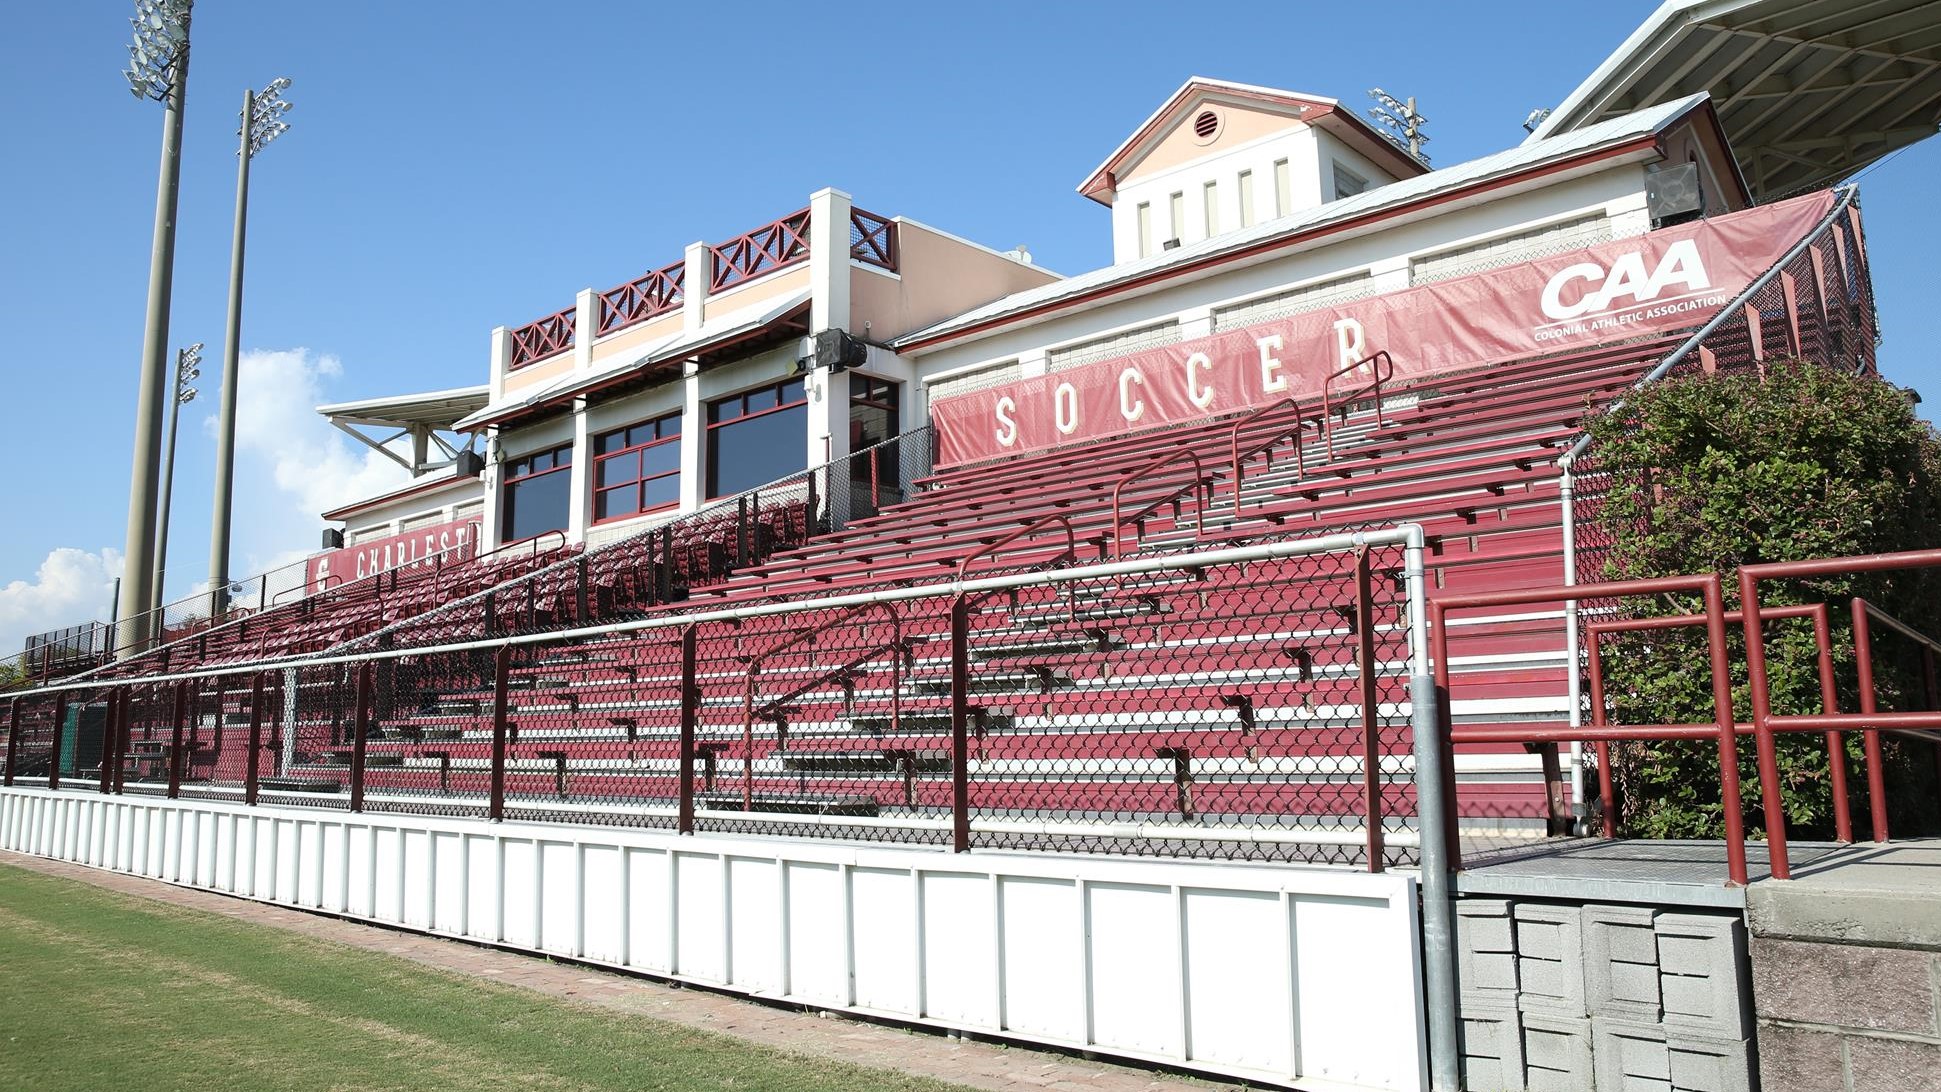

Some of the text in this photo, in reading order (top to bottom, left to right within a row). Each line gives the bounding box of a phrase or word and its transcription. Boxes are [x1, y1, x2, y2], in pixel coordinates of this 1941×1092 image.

[1534, 294, 1727, 342] COLONIAL ATHLETIC ASSOCIATION
[1540, 238, 1711, 320] CAA
[995, 317, 1374, 447] SOCCER
